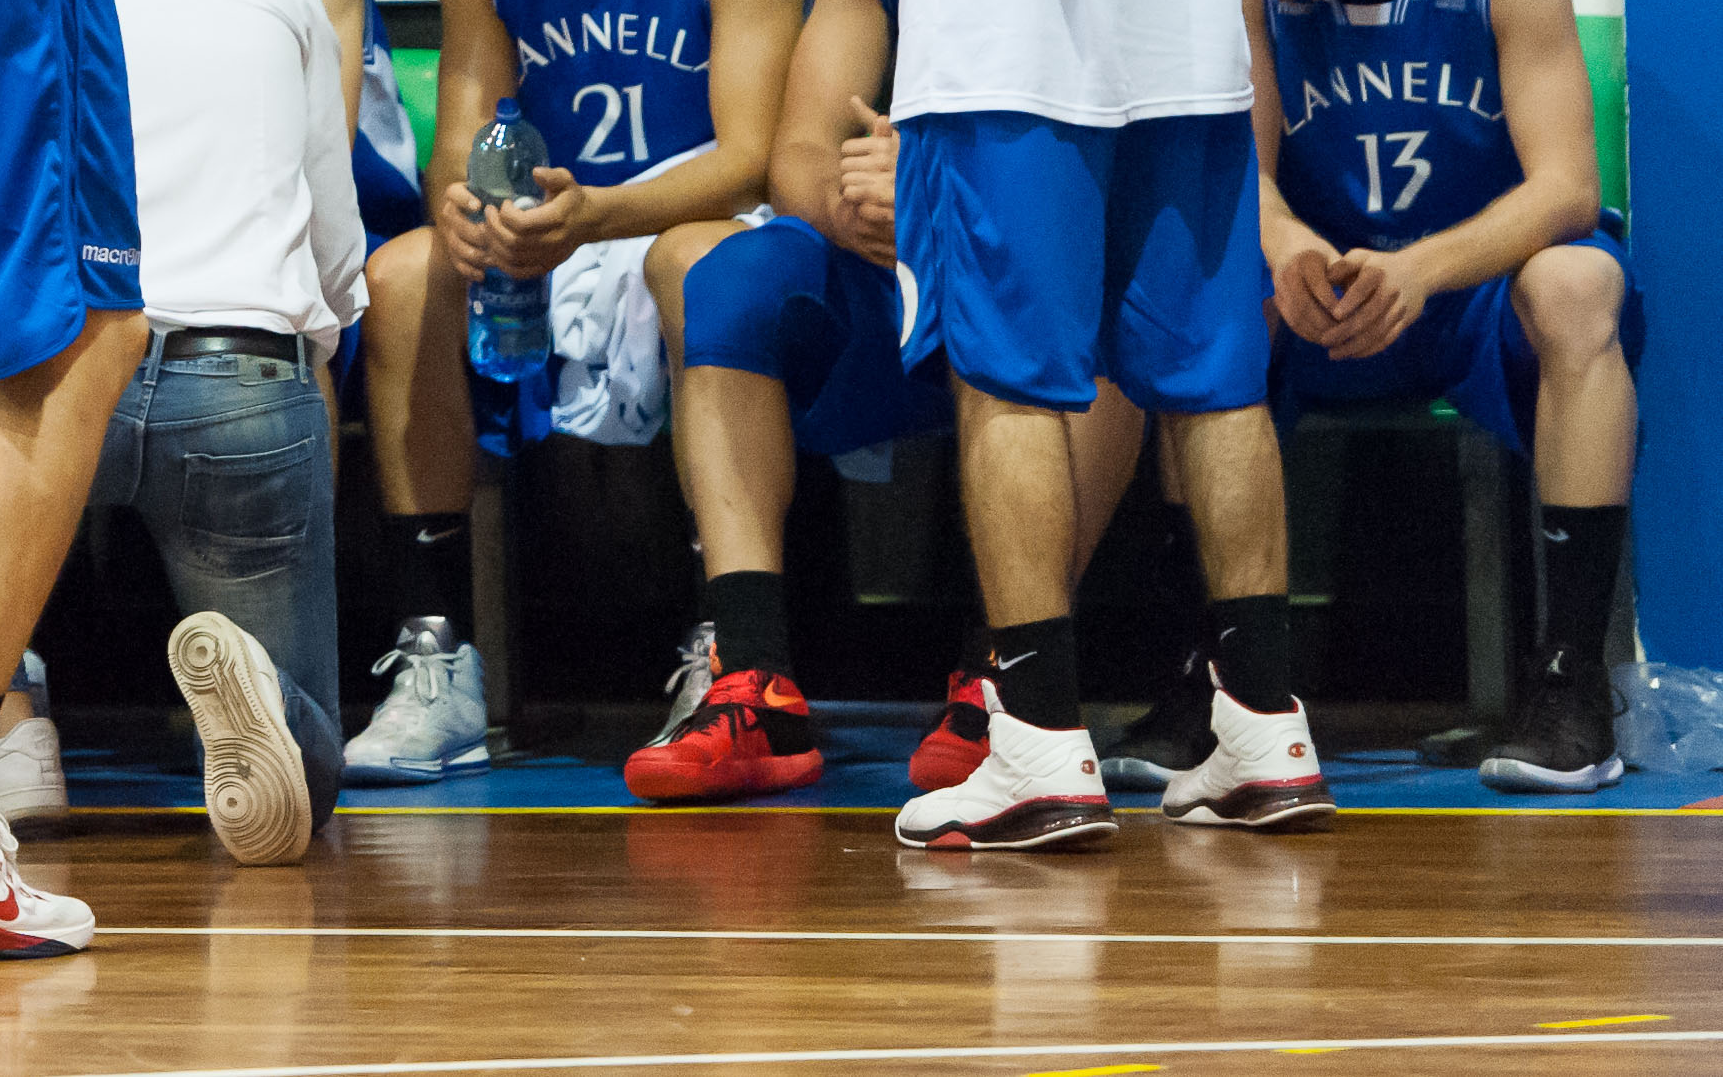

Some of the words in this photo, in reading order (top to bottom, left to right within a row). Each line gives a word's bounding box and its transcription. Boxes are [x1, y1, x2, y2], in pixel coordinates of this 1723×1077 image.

[517, 10, 710, 86] ANNELL
[572, 83, 650, 164] 21
[1356, 130, 1432, 213] 13
